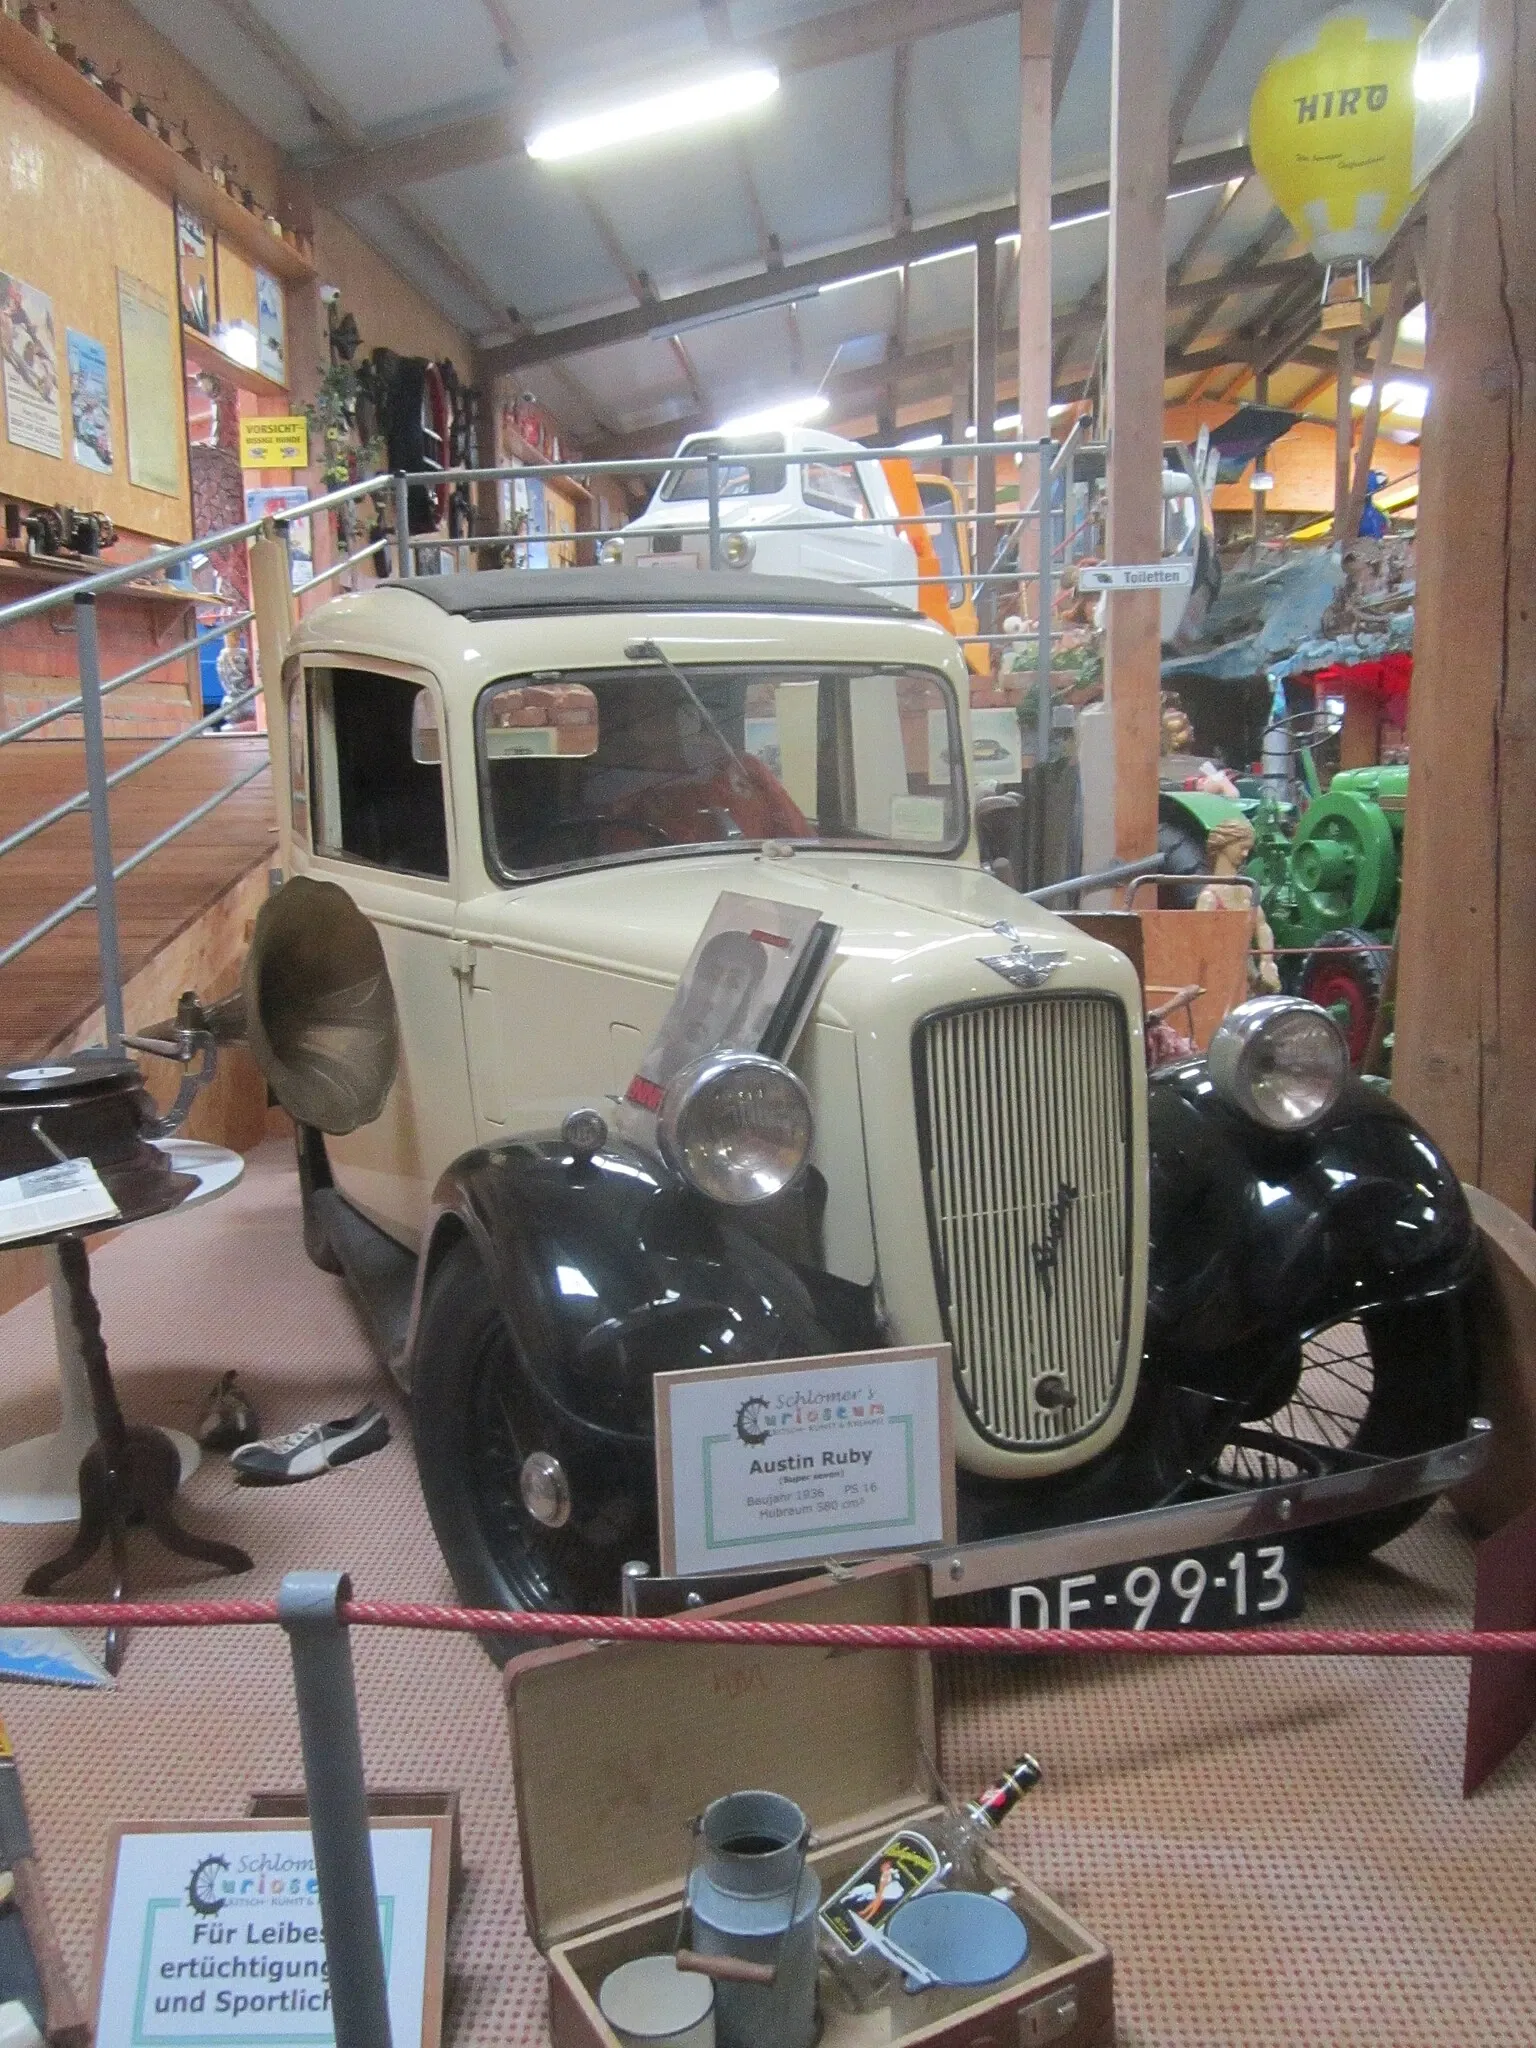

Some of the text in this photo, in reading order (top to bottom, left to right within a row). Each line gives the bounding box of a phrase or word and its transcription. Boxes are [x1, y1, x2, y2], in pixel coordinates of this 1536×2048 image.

[1293, 83, 1389, 125] HIRO
[245, 423, 298, 434] VORSICHT
[1123, 570, 1180, 584] Toiletten
[749, 1447, 874, 1476] Austin Ruby
[746, 1490, 793, 1508] Baujahr
[844, 1483, 860, 1496] PS
[863, 1481, 878, 1494] 16
[759, 1503, 814, 1520] Hubraum
[238, 1852, 316, 1874] Schlom
[193, 1922, 237, 1945] Für
[155, 1989, 206, 2014] und
